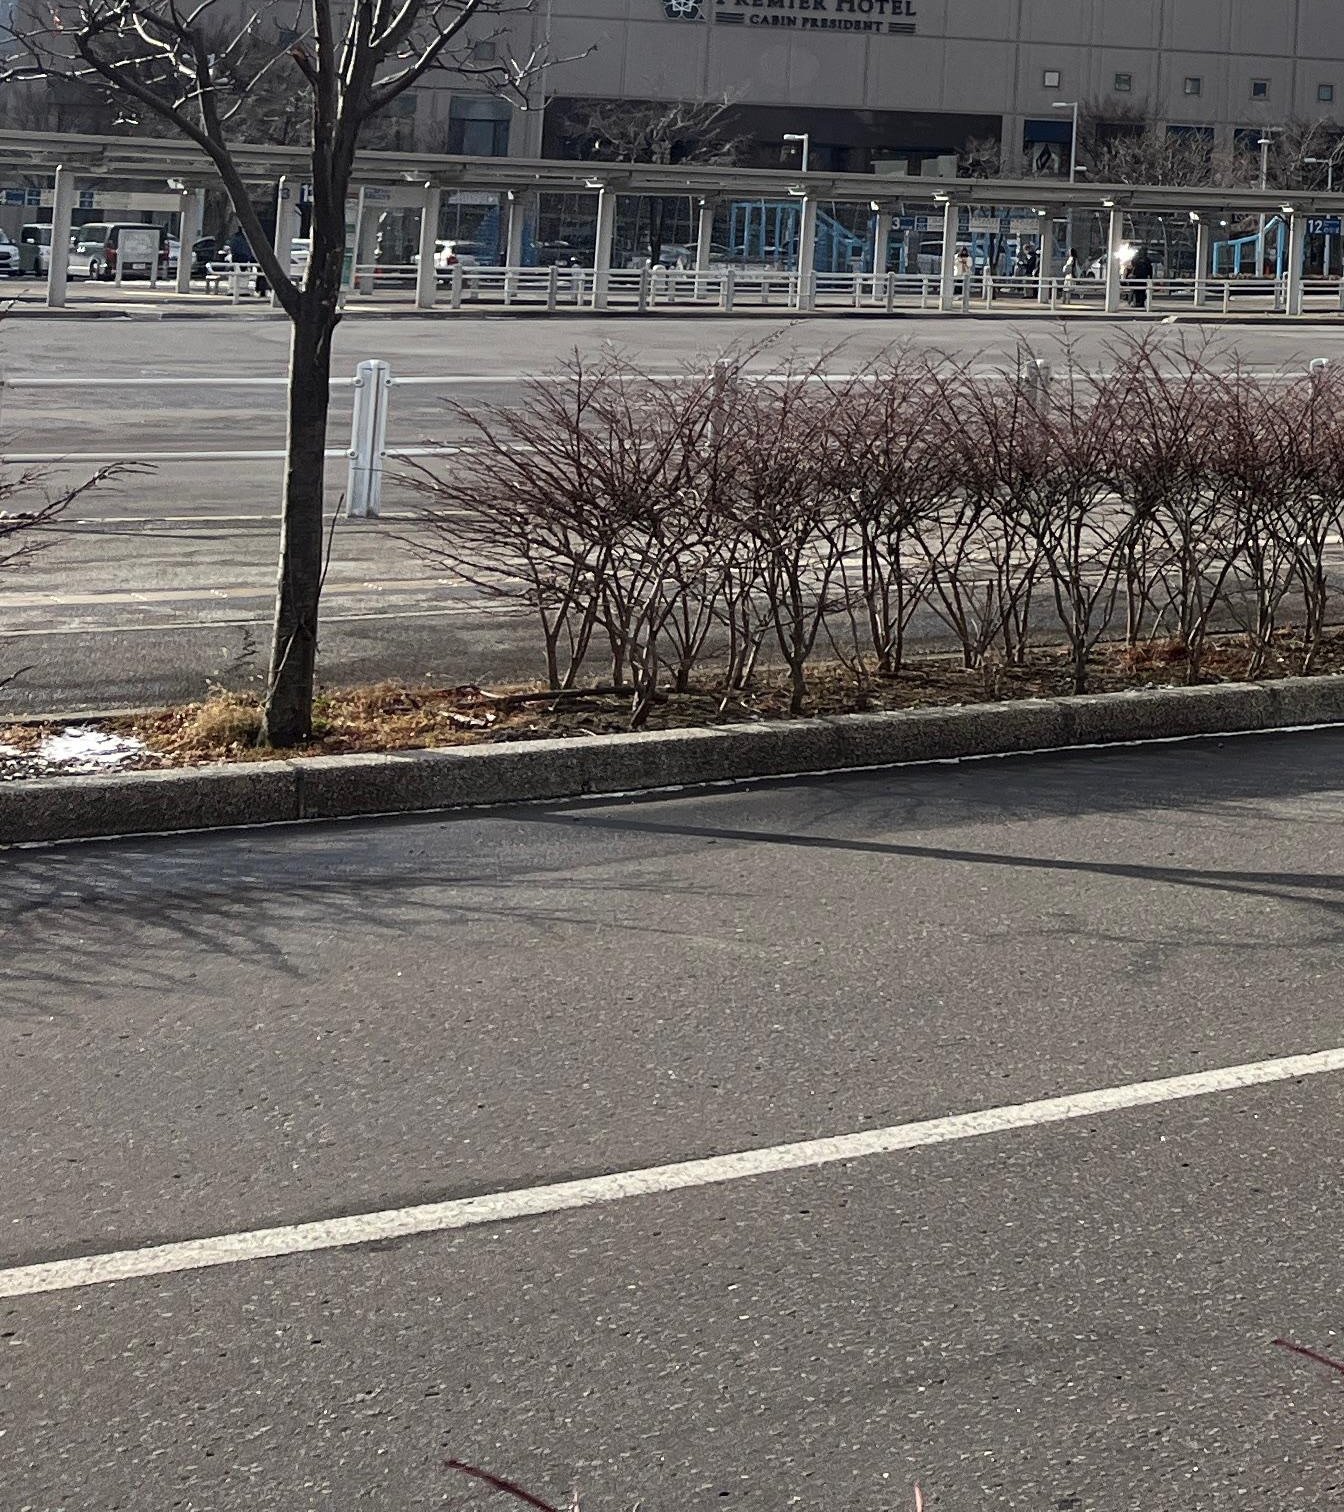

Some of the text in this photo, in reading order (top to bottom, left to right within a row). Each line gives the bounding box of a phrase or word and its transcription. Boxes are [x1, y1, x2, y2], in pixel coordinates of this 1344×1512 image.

[750, 14, 884, 32] CABIN PRESIDENT
[1308, 220, 1323, 234] 12
